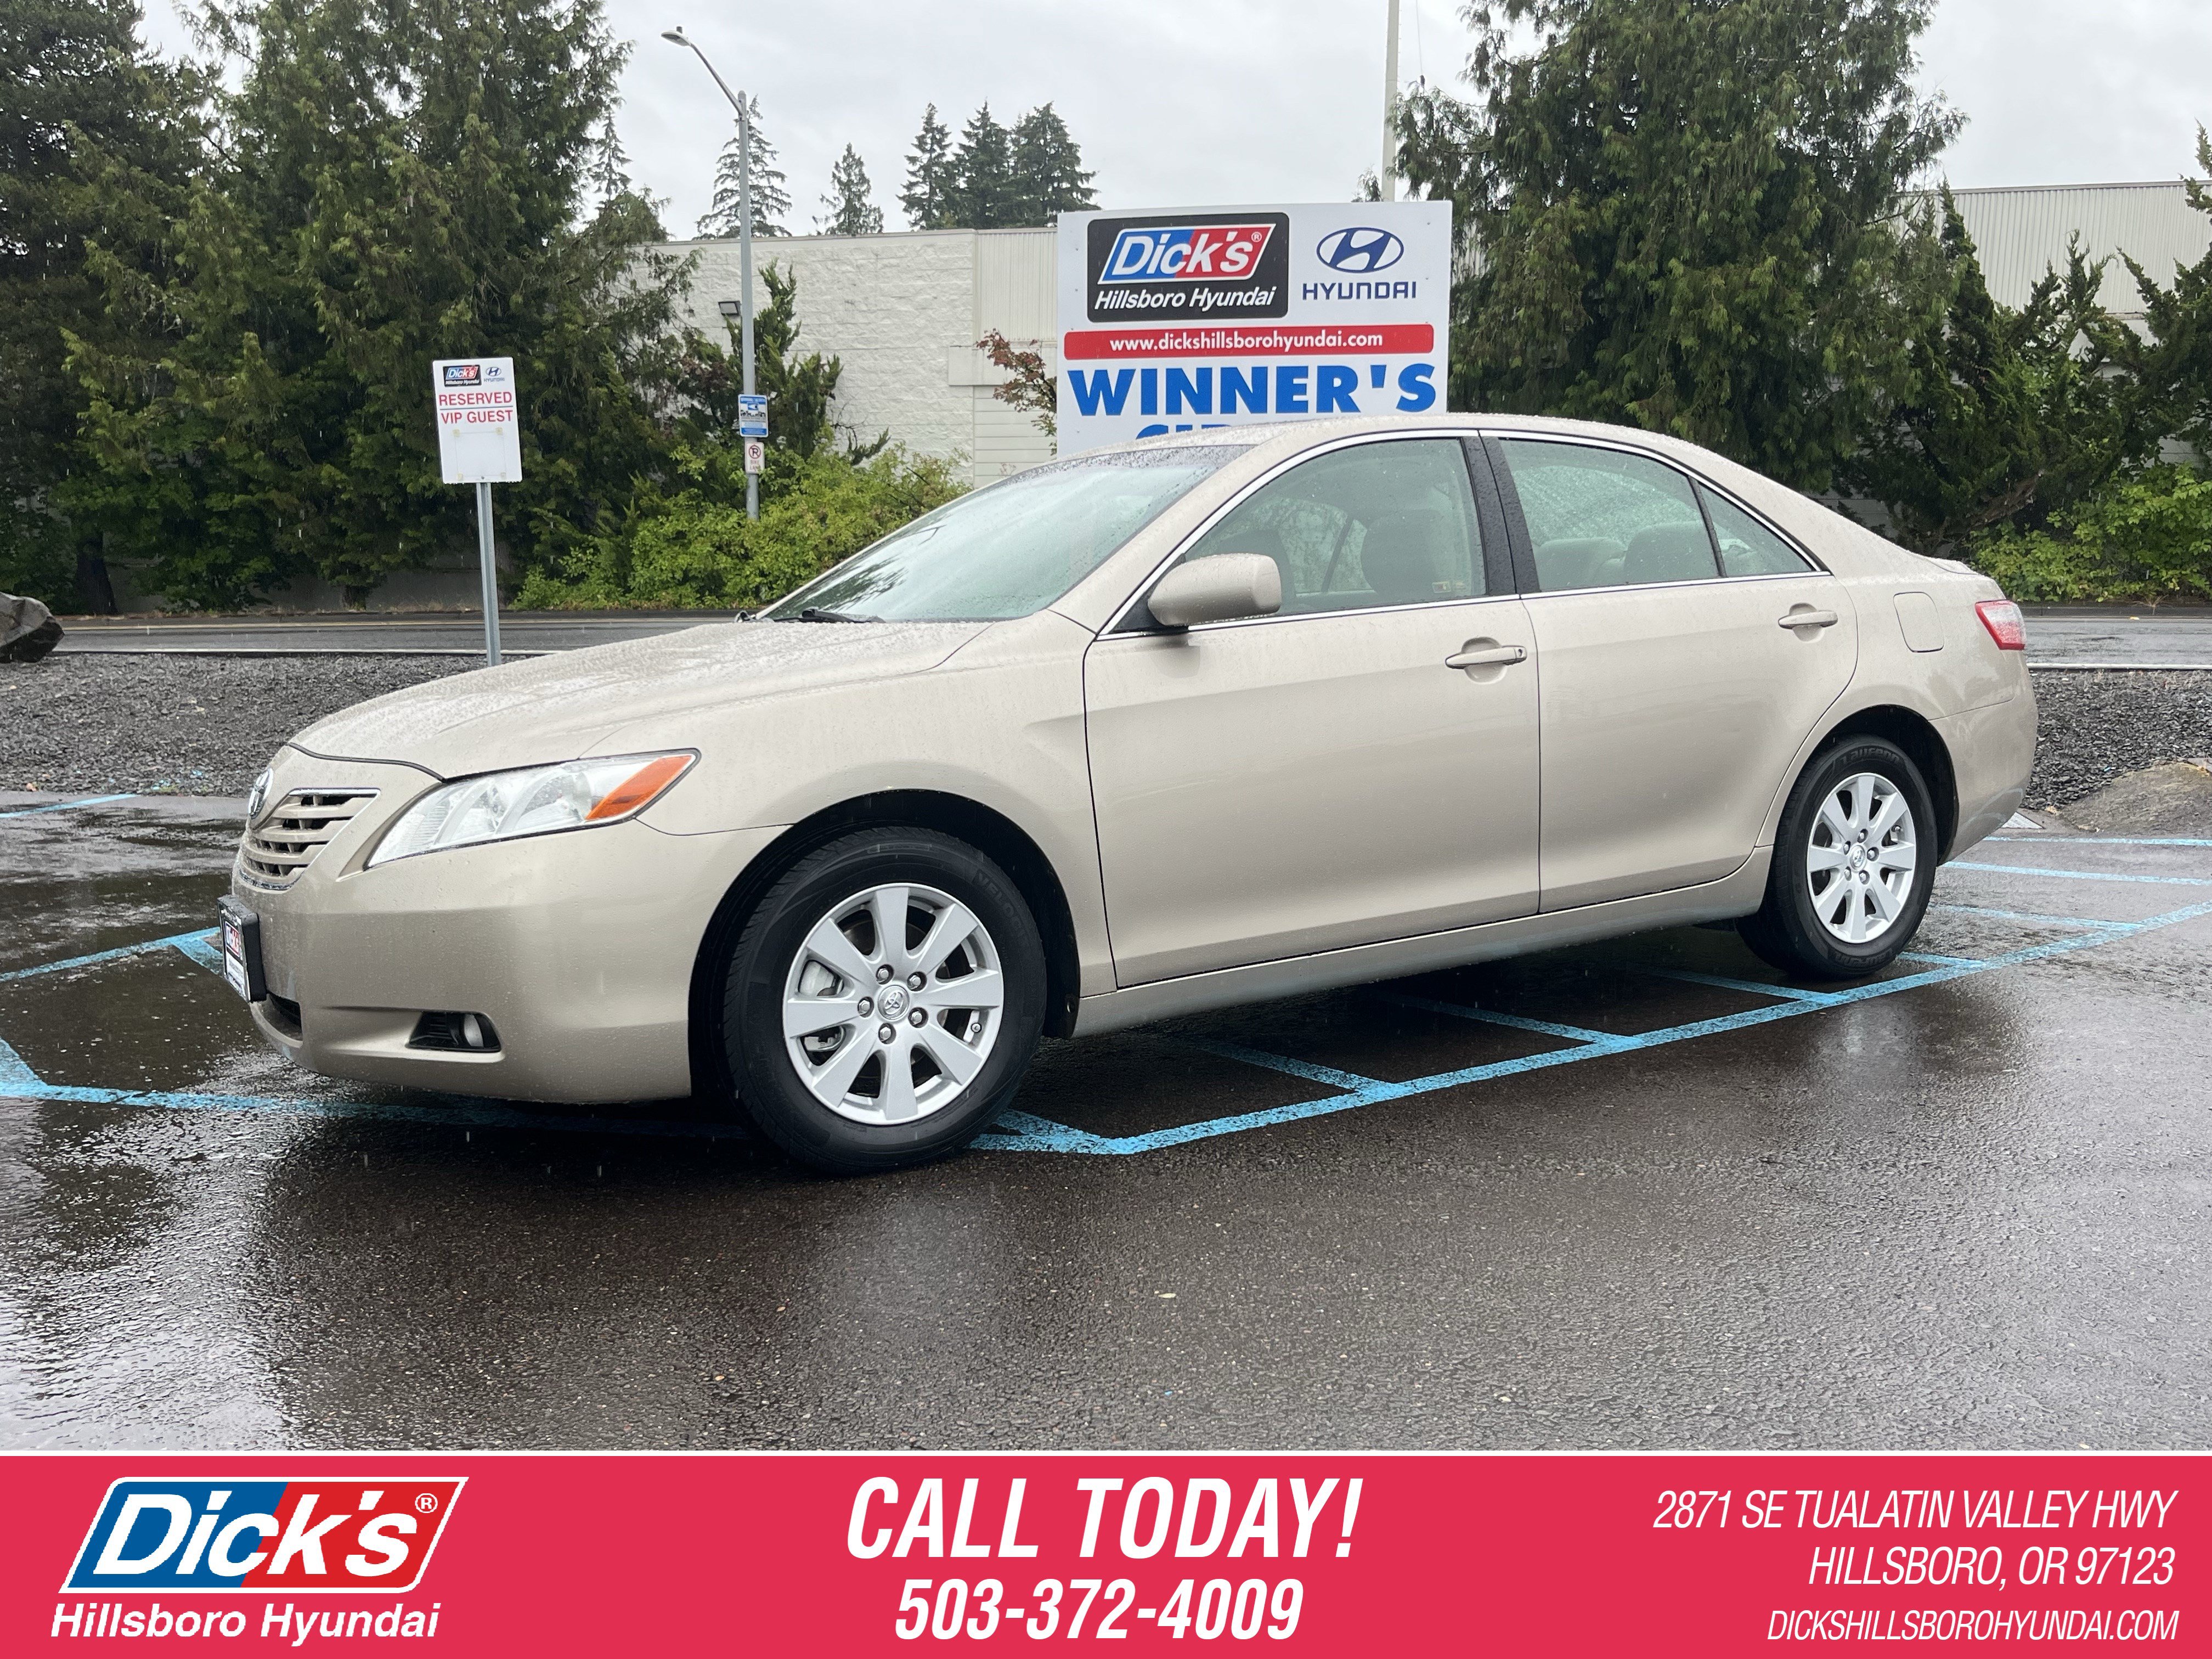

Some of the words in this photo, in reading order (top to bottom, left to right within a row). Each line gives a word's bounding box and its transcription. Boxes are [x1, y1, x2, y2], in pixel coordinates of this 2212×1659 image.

[1094, 289, 1186, 309] Hillsboro
[1189, 286, 1277, 312] Hyundai
[1302, 281, 1416, 301] HYUNDAI
[1110, 330, 1383, 352] www.dickshillsborohyundai.com
[439, 391, 512, 406] RESERVED
[1067, 363, 1437, 416] WINNER'S
[441, 412, 462, 424] VIP
[466, 410, 513, 423] GUEST
